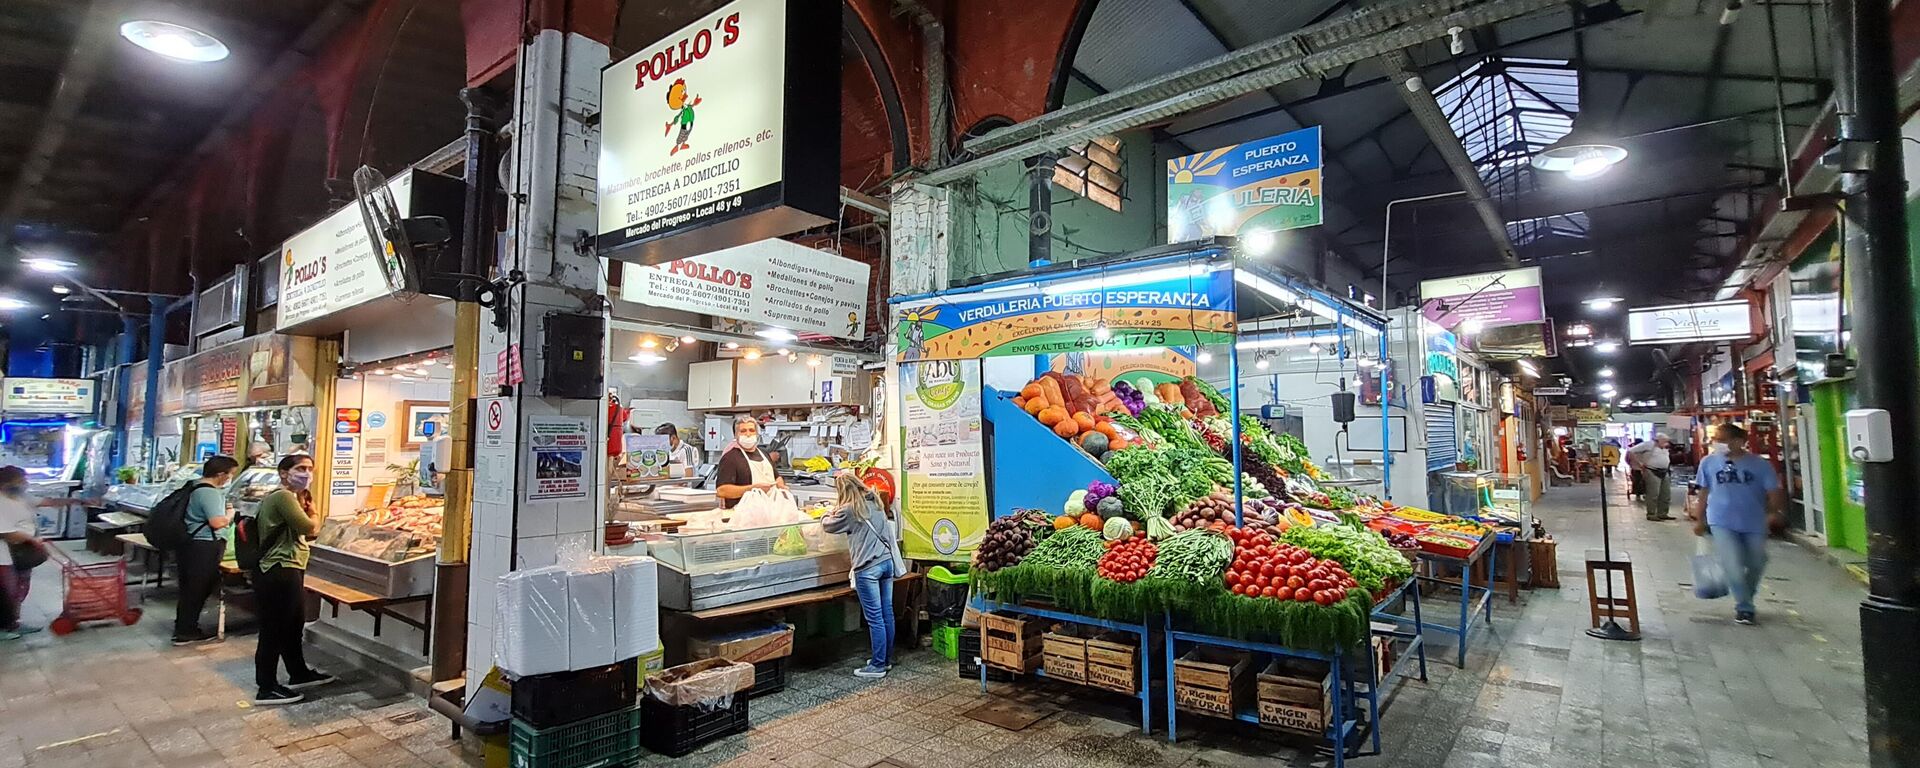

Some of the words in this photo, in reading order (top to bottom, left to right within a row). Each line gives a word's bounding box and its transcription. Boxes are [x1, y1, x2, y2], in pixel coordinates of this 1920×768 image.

[645, 165, 683, 183] brochette,
[685, 151, 711, 169] pollos
[713, 136, 753, 158] rellenos,
[756, 128, 774, 143] etc.
[1245, 142, 1297, 161] PUERTO
[1232, 154, 1309, 177] ESPERANZA
[628, 181, 671, 205] ENTREGA
[673, 178, 681, 191] A
[683, 158, 740, 187] DOMICILIO
[626, 212, 643, 224] Tel.:
[644, 178, 741, 217] 4902-5607/4901-7351
[625, 222, 651, 238] Mercado
[651, 220, 661, 231] del
[662, 213, 691, 230] Progreso
[695, 206, 715, 218] Local
[716, 201, 726, 212] 48
[726, 201, 732, 212] y
[732, 195, 742, 207] 49
[772, 257, 808, 274] Albondigas
[648, 272, 695, 288] ENTREGA
[697, 282, 704, 290] A
[706, 284, 751, 299] DOMICILIO
[770, 270, 808, 286] Medallones
[809, 280, 817, 288] de
[818, 283, 834, 292] pollo
[648, 281, 668, 292] Tel.:
[670, 286, 751, 307] 4902-5607/4901-7351
[648, 289, 674, 300] Mercado
[686, 297, 711, 307] Progreso
[716, 303, 731, 311] Local
[769, 283, 806, 298] Brochettes
[809, 292, 834, 304] Conejos
[840, 300, 861, 310] pavitas
[768, 297, 803, 311] Arrollados
[804, 304, 812, 312] de
[813, 306, 830, 315] pollo
[958, 296, 1041, 323] VERDULERIA
[1042, 293, 1101, 308] PUERTO
[1106, 291, 1210, 308] ESPERANZA
[767, 309, 800, 323] Supremas
[801, 316, 826, 327] rellenas
[1012, 344, 1040, 353] ENVIOS
[1041, 343, 1051, 351] AL
[948, 458, 971, 468] Natural
[956, 449, 980, 458] Producto
[1045, 666, 1083, 679] NATURAL
[1089, 670, 1131, 687] NATURAL
[1177, 695, 1228, 713] NATURAL
[1262, 713, 1321, 731] NATURAL
